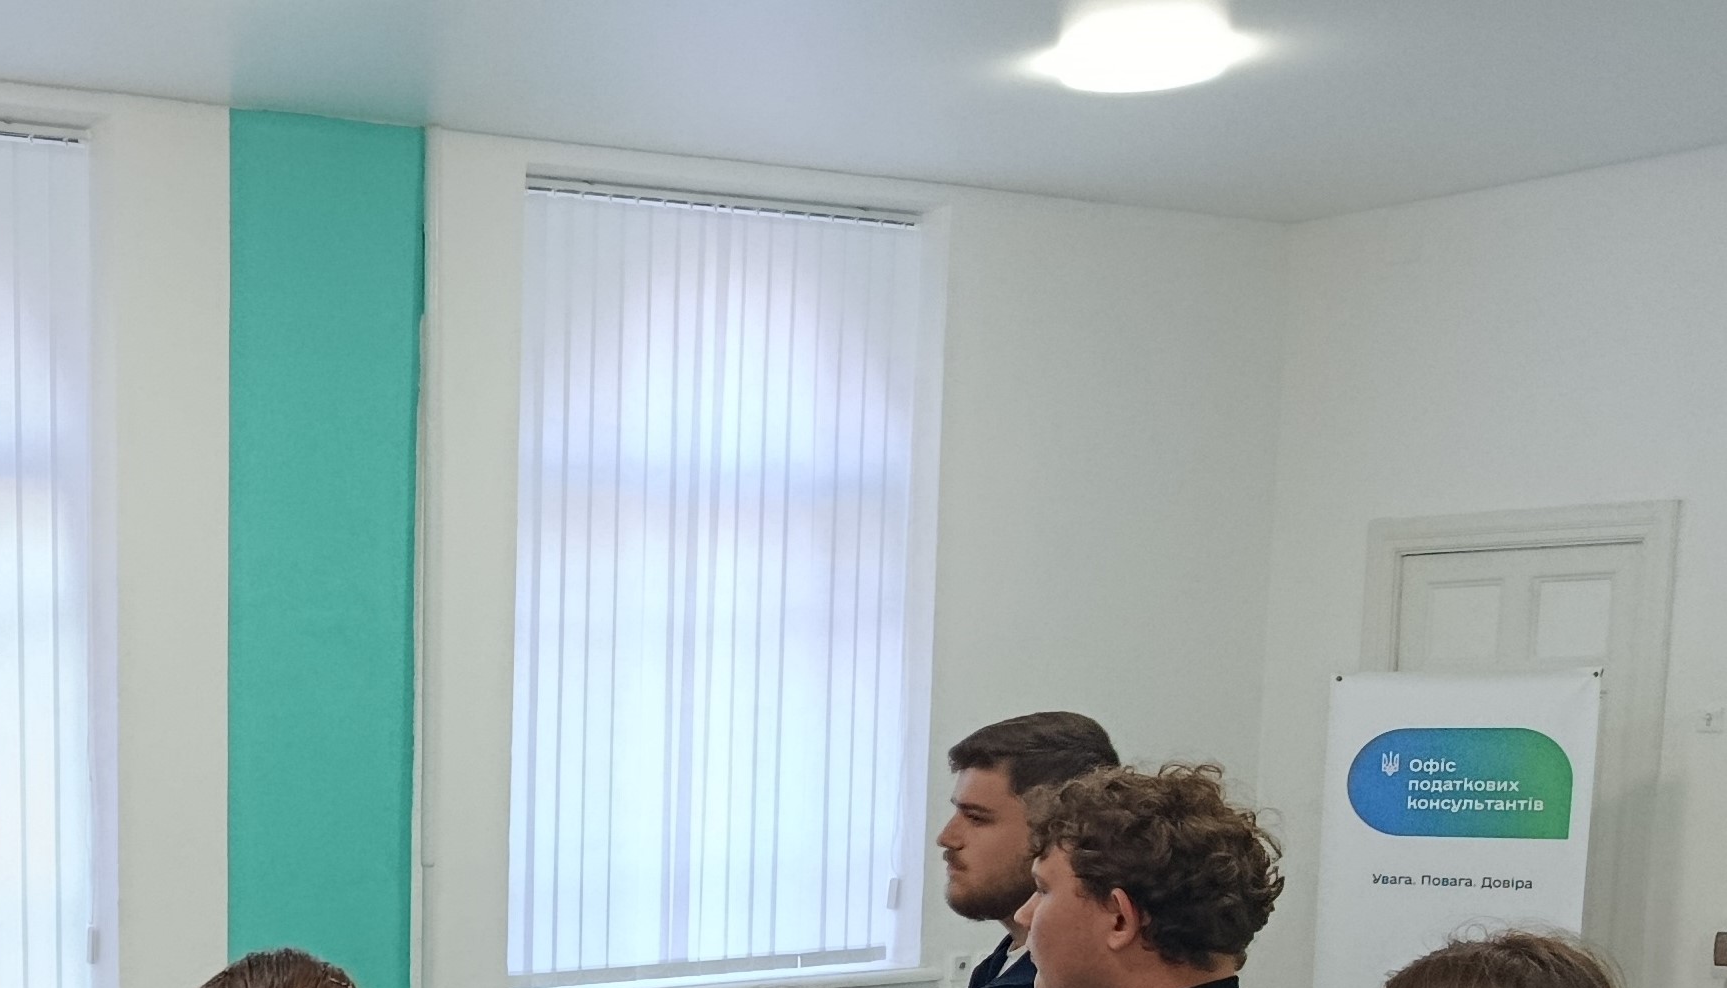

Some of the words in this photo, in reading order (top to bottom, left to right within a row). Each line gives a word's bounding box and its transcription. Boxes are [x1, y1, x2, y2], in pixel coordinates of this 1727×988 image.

[1409, 757, 1456, 774] Офіс
[1407, 777, 1519, 793] податкових
[1407, 796, 1544, 812] консультантів
[1372, 873, 1416, 885] Увага.
[1421, 874, 1476, 887] Повага.
[1481, 876, 1533, 890] Довіра
